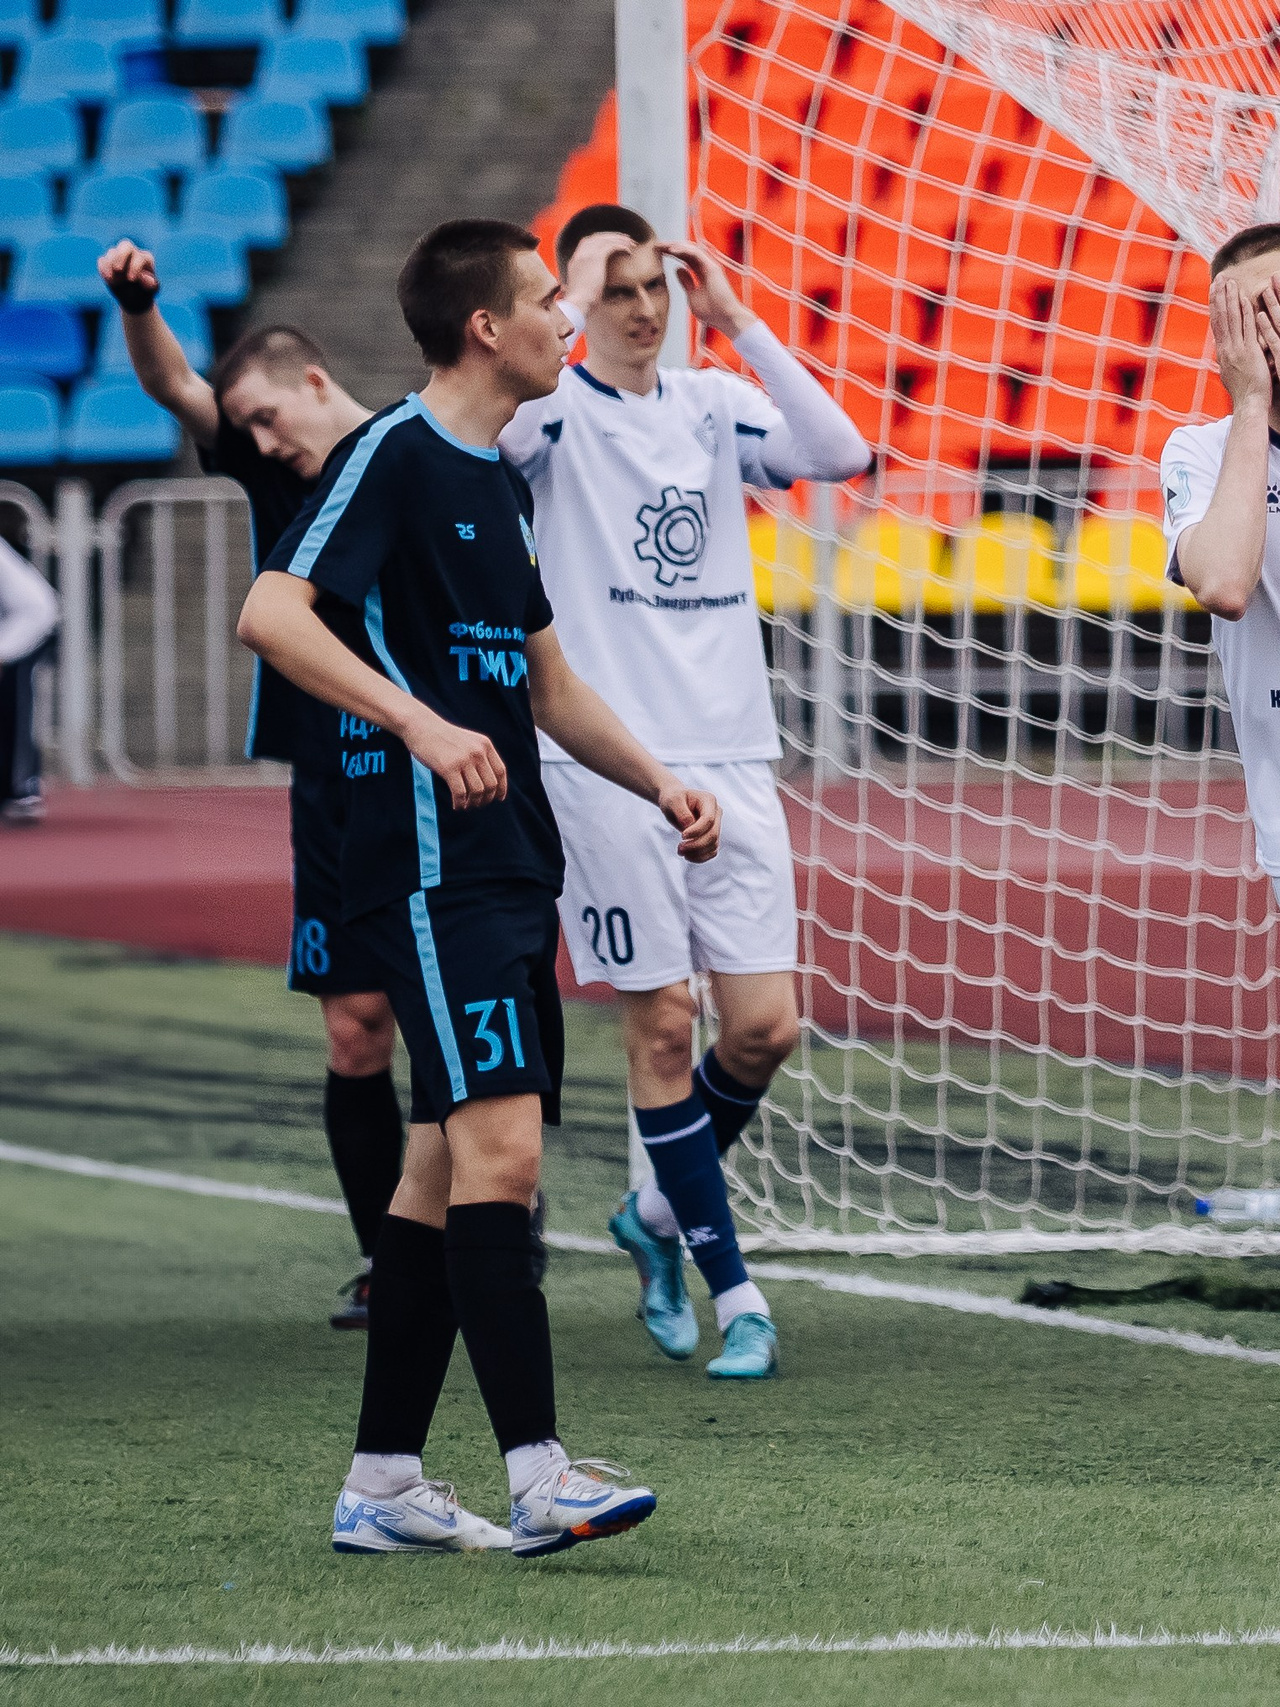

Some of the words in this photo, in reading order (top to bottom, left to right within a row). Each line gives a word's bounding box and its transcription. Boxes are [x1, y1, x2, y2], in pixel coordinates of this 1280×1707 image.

[296, 917, 331, 976] 18
[583, 906, 635, 966] 20
[464, 998, 526, 1072] 31
